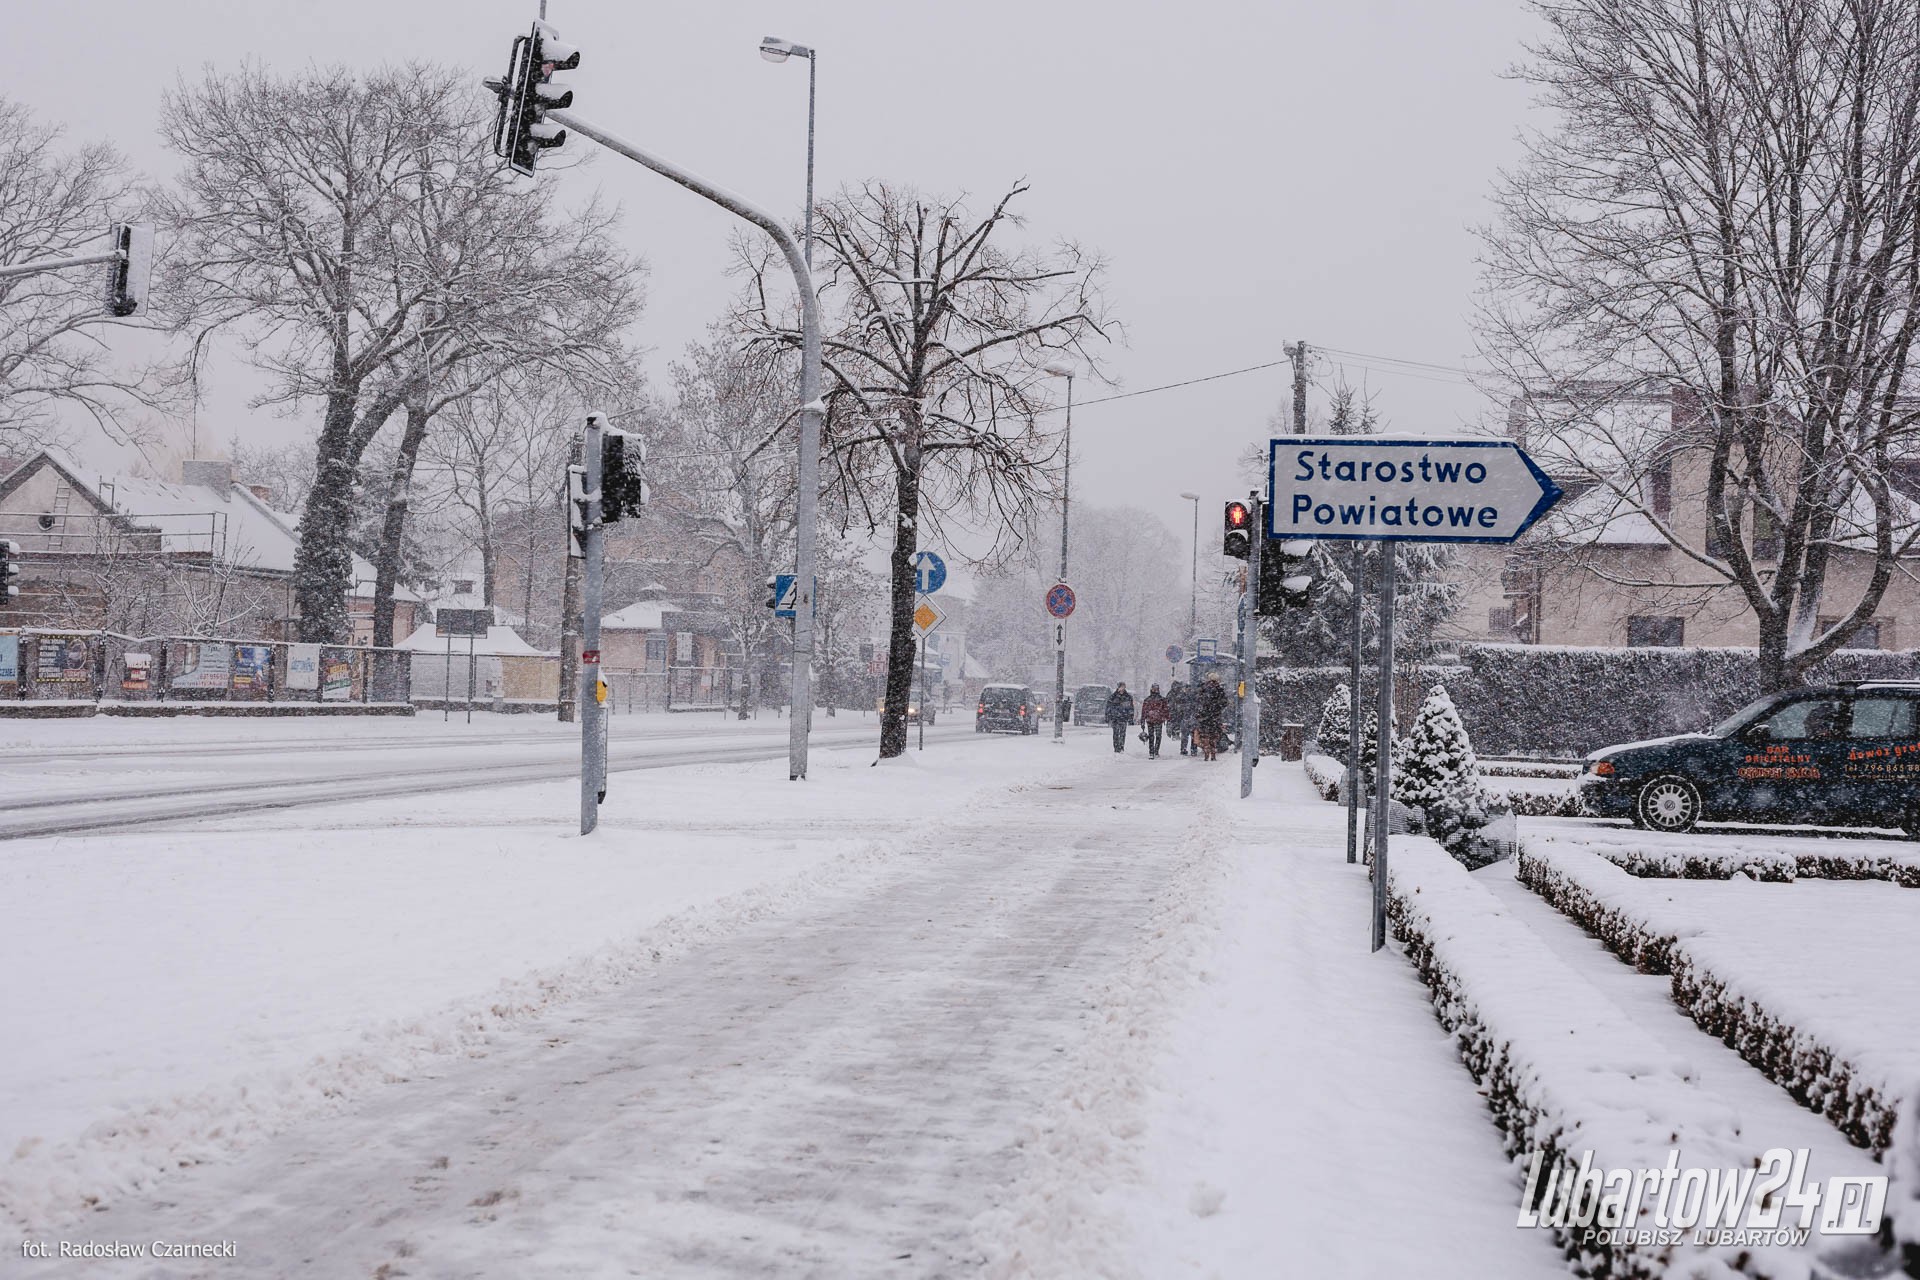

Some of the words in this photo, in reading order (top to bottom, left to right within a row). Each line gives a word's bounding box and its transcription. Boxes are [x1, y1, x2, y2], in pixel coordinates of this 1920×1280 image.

[1295, 450, 1487, 484] Starostwo
[1293, 494, 1498, 528] Powiatowe
[1745, 754, 1811, 763] ORIENTALNY
